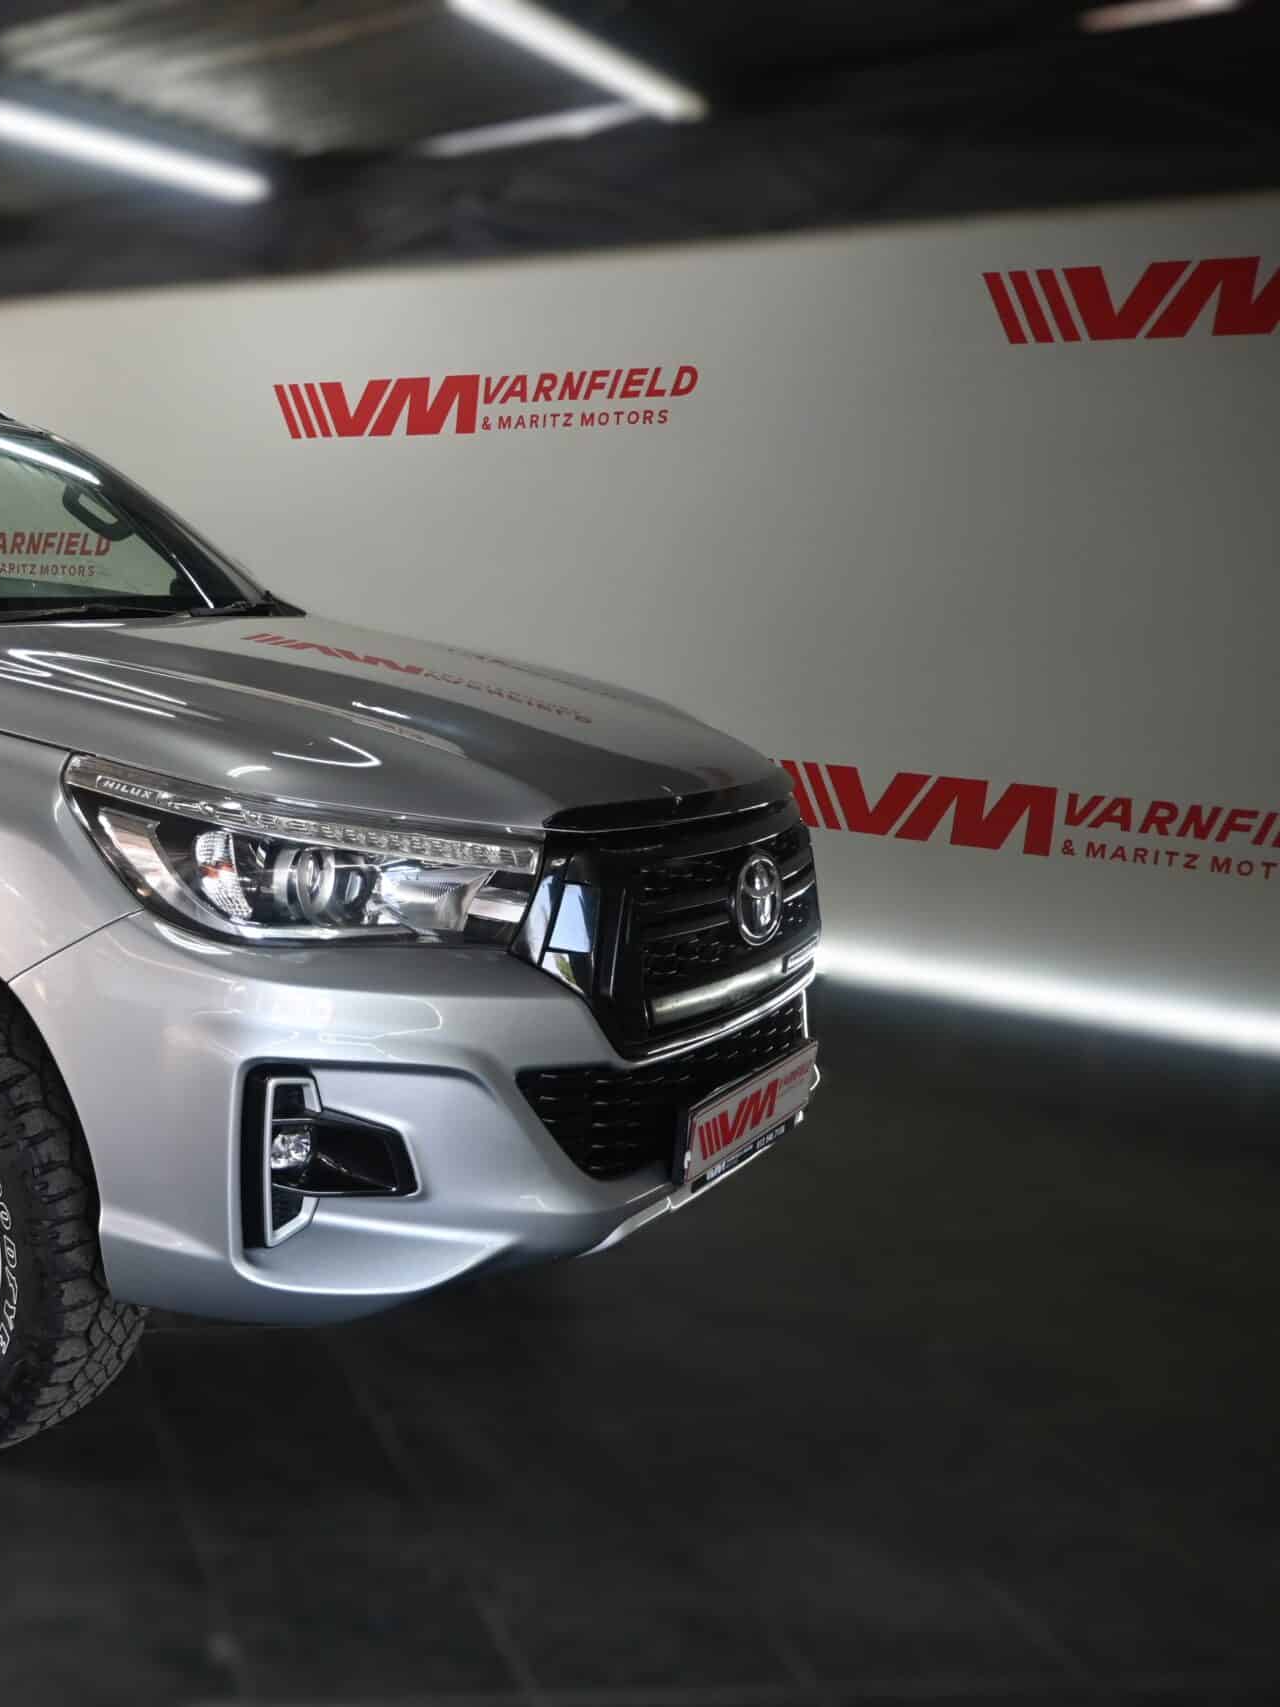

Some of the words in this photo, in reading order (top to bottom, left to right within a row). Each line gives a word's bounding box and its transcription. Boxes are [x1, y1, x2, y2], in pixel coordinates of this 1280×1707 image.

[482, 365, 699, 405] VARNFIELD
[320, 374, 480, 438] VM
[482, 415, 492, 431] &
[497, 412, 573, 431] MARITZ
[581, 409, 669, 427] MOTORS
[40, 564, 96, 577] MOTORS
[103, 780, 154, 799] HILUX
[825, 764, 1058, 857] VM
[1064, 792, 1280, 849] VARNFI
[1061, 839, 1076, 856] &
[1086, 842, 1198, 870] MARITZ
